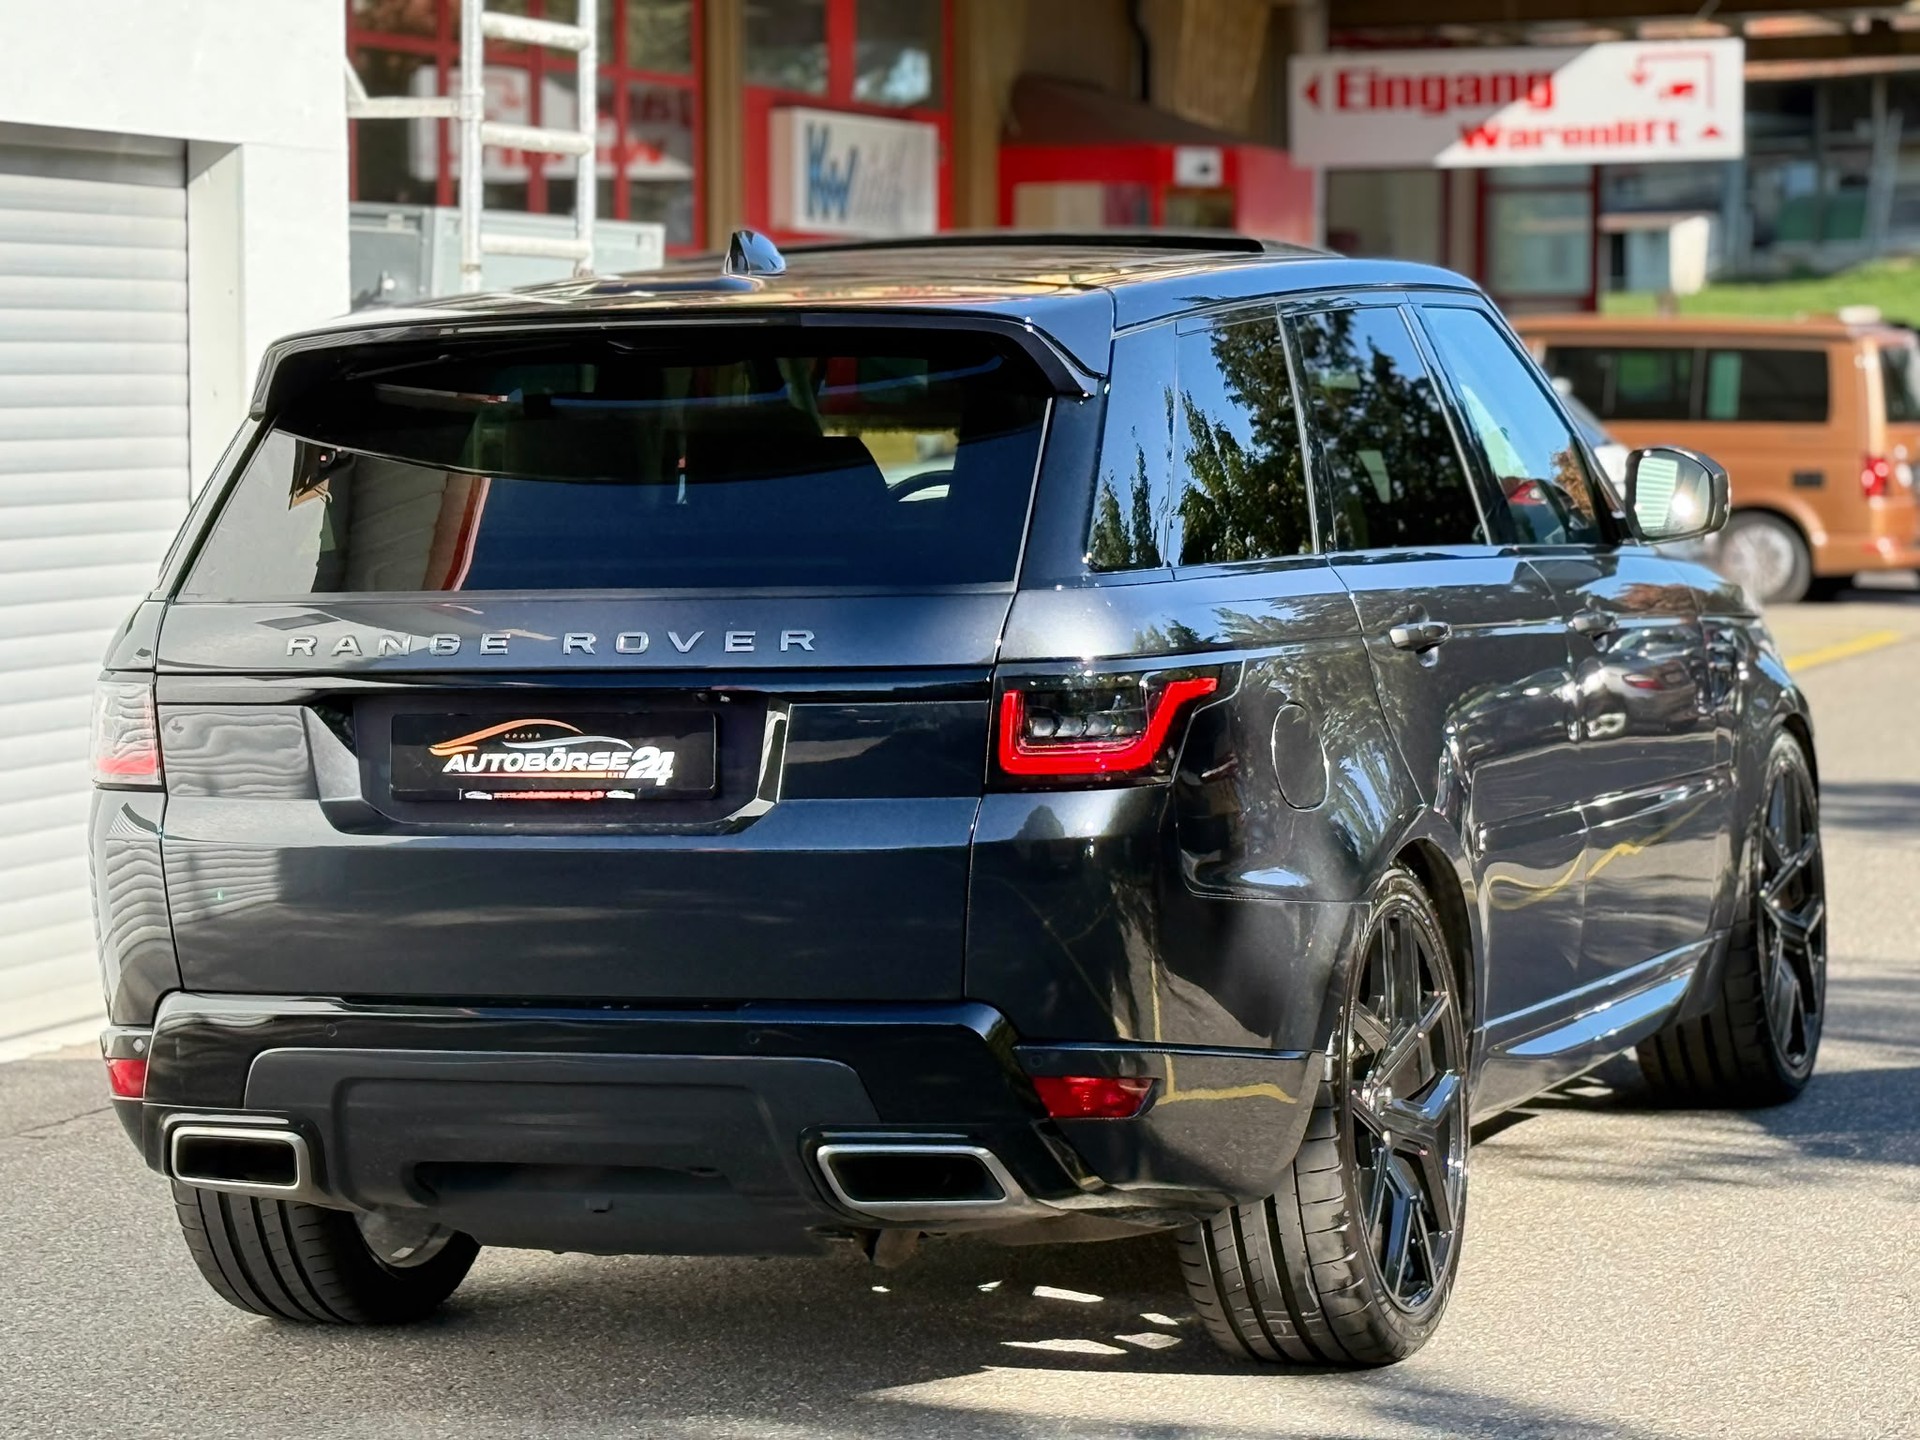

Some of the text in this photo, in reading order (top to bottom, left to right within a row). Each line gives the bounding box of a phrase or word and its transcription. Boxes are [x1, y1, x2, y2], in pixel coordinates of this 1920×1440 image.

[1335, 67, 1556, 112] Eingang
[1460, 119, 1679, 150] Warenlift
[286, 629, 817, 657] RANGE ROVER
